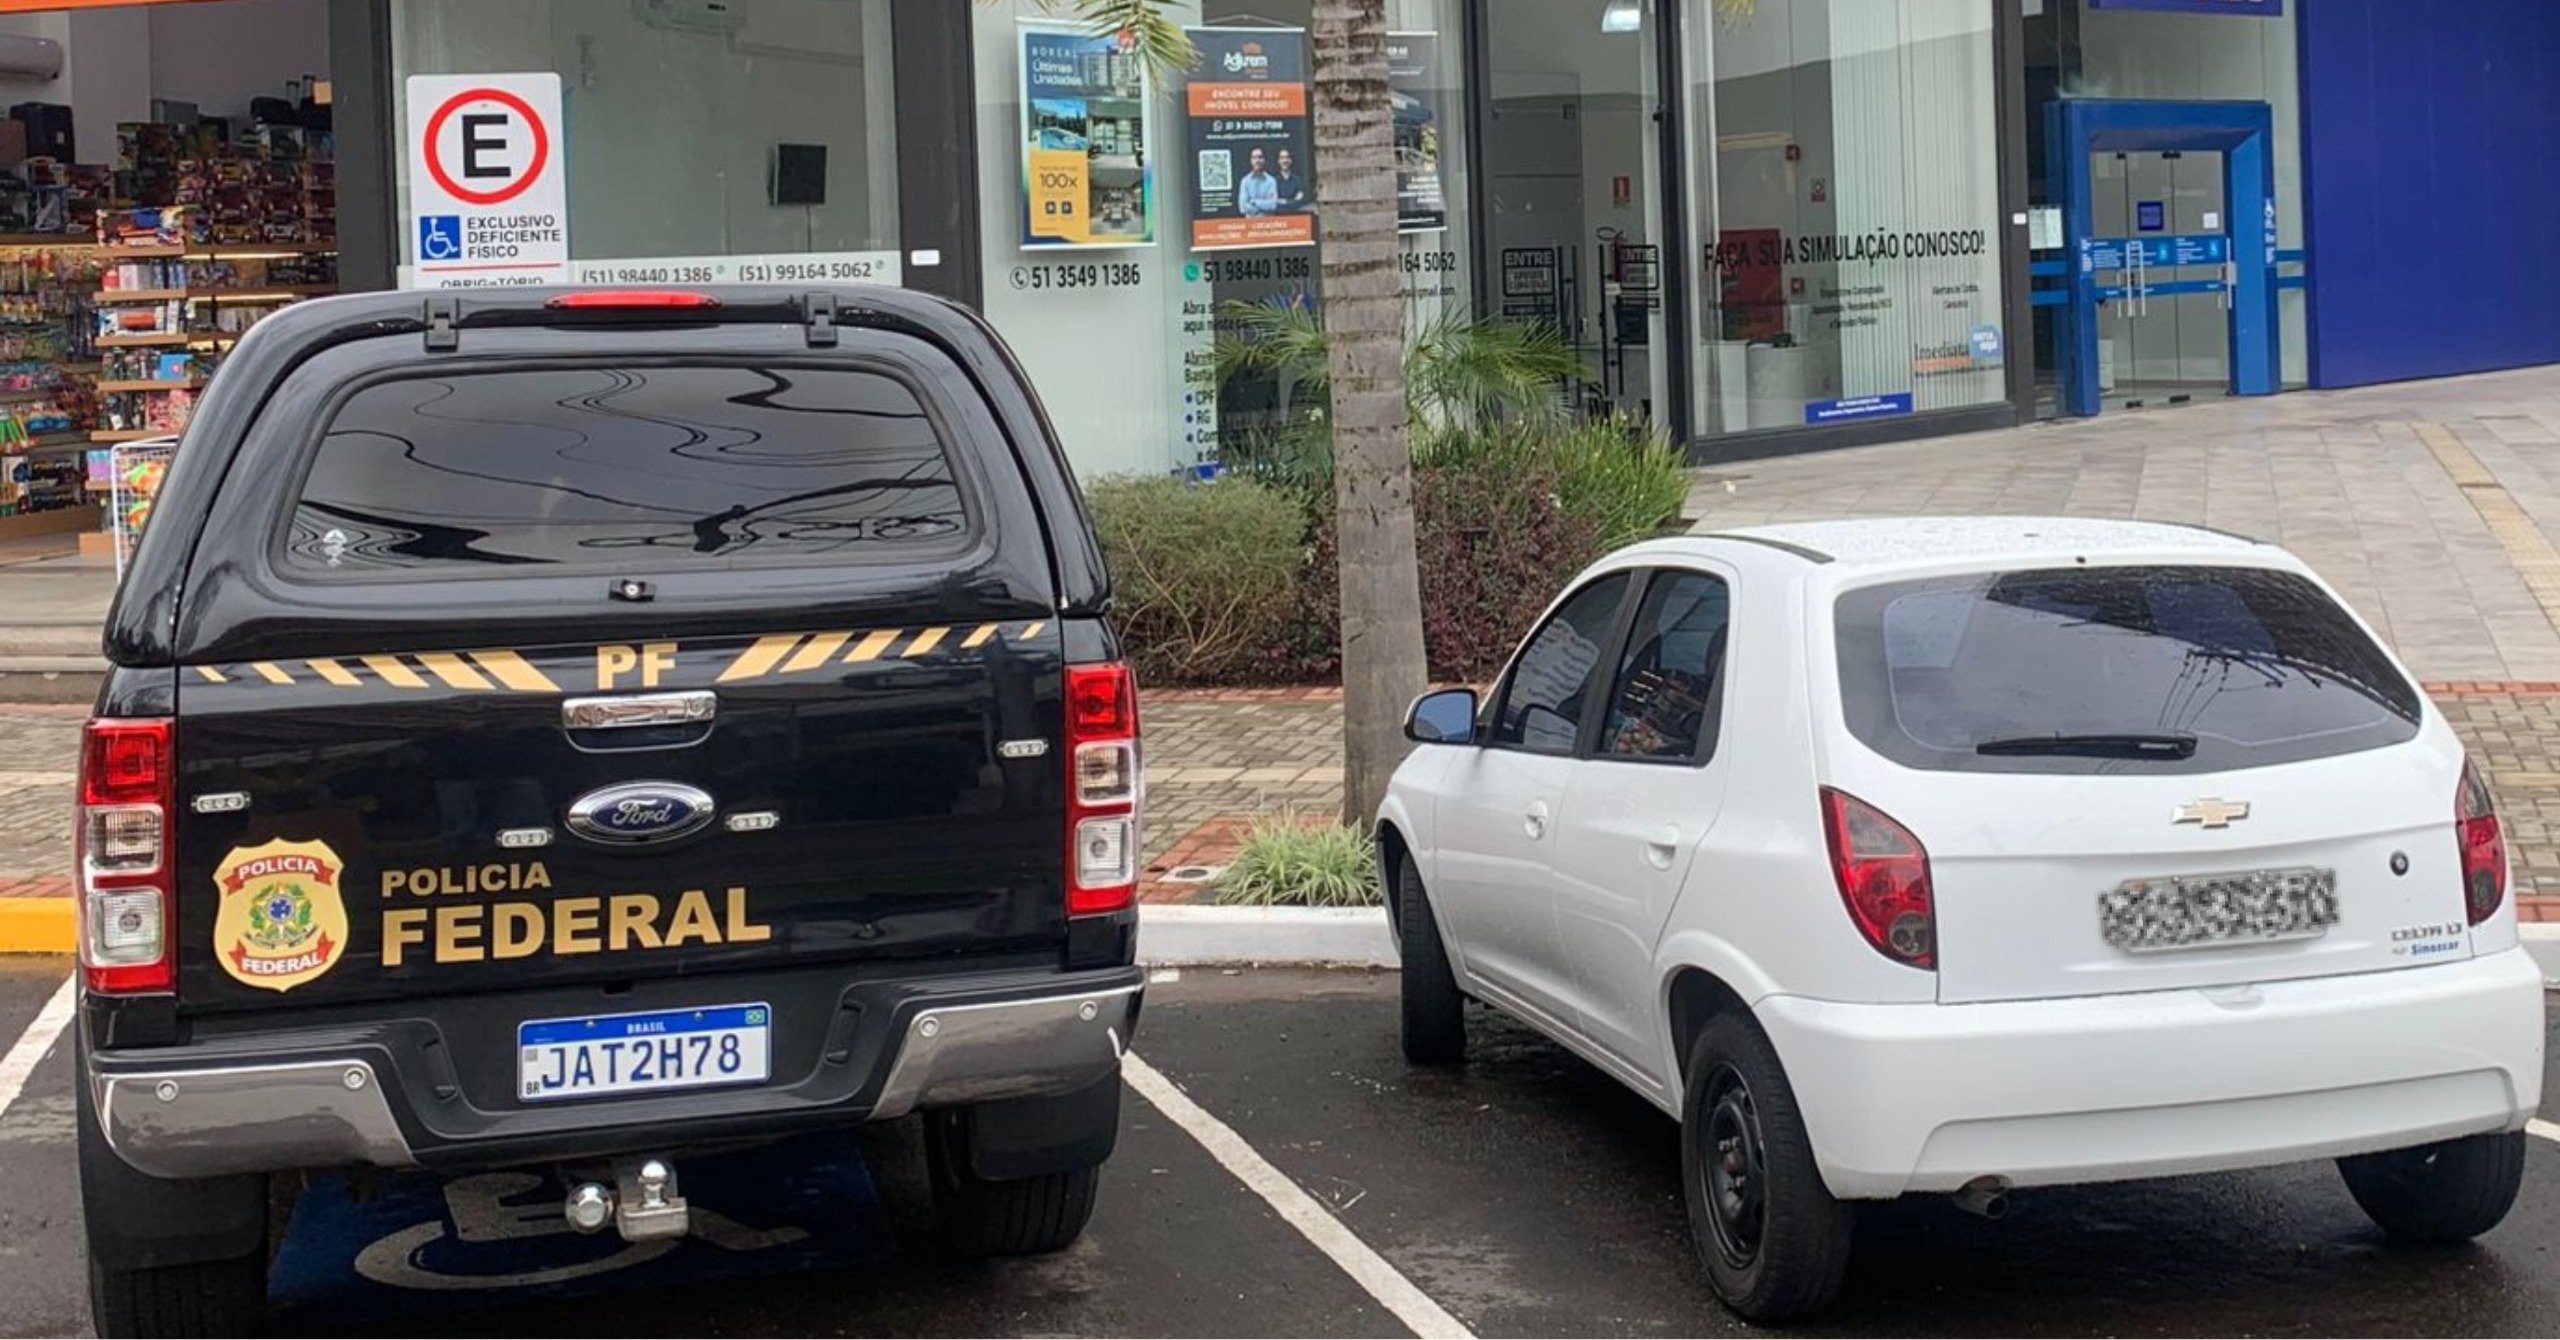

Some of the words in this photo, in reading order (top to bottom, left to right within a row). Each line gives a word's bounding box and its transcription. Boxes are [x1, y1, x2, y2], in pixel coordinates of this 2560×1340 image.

[1033, 59, 1072, 73] Últimas
[1033, 73, 1083, 86] Unidades
[462, 114, 512, 178] E
[1038, 173, 1078, 189] 100x
[467, 214, 555, 230] EXCLUSIVO
[467, 229, 561, 244] DEFICIENTE
[1757, 237, 1796, 266] SUA
[1799, 227, 1899, 268] SIMULAÇÃO
[1903, 229, 1986, 259] CONOSCO!
[1504, 251, 1553, 267] ENTRE
[673, 266, 712, 282] 1386
[738, 264, 771, 281] (51)
[775, 262, 827, 280] 99164
[831, 261, 872, 279] 5062
[1032, 266, 1050, 288] 51
[1056, 265, 1097, 288] 3549
[1102, 263, 1141, 286] 1386
[1203, 260, 1220, 282] 51
[1225, 258, 1271, 280] 98440
[596, 642, 678, 690] PF
[612, 798, 672, 827] Ford
[381, 886, 771, 967] FEDERAL
[241, 952, 322, 974] FEDERAL
[626, 1021, 666, 1035] BRASIL
[541, 1033, 742, 1089] JAT2H78
[526, 1080, 541, 1095] BR
